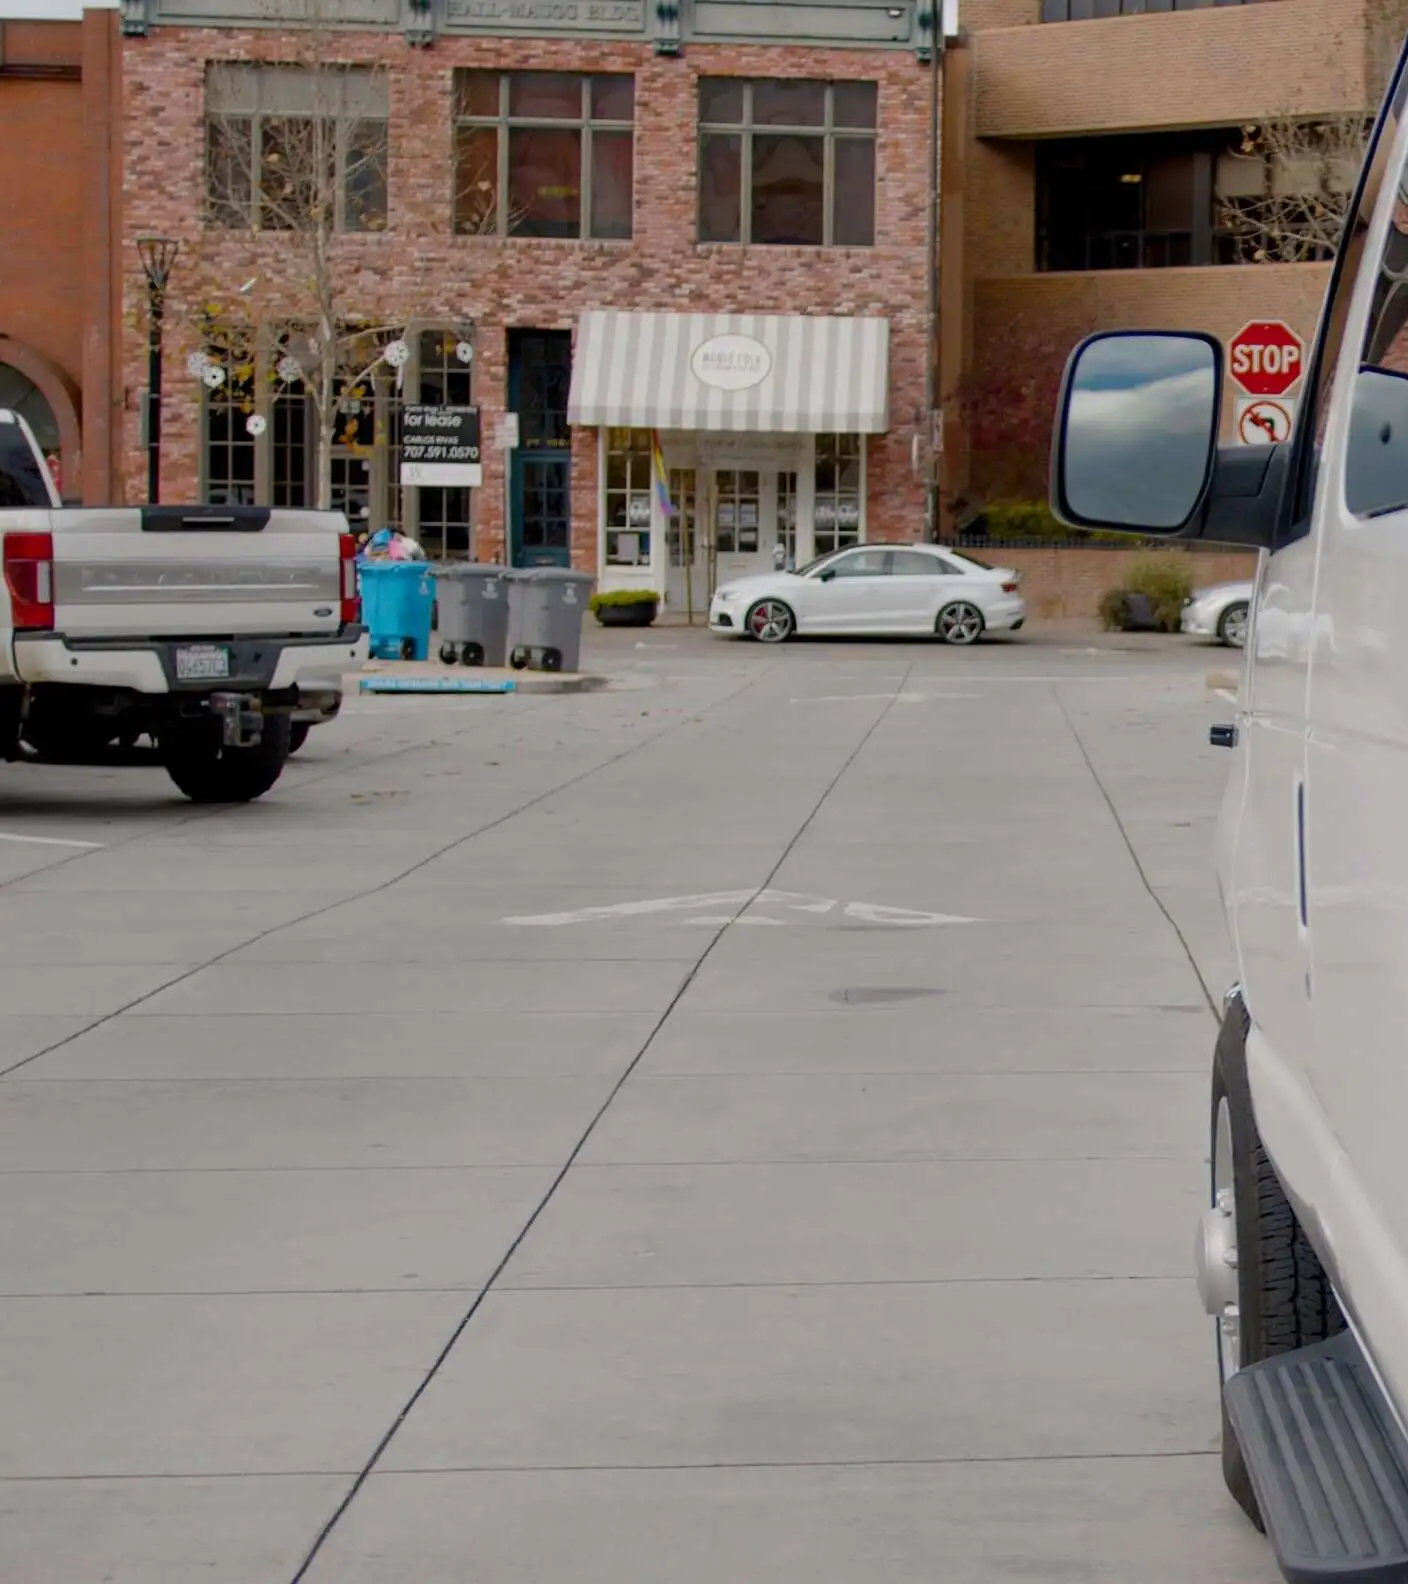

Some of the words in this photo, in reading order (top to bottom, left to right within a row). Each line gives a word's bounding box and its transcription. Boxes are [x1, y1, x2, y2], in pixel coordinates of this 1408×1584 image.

[1232, 343, 1299, 375] STOP
[403, 411, 421, 427] for
[424, 413, 462, 428] lease
